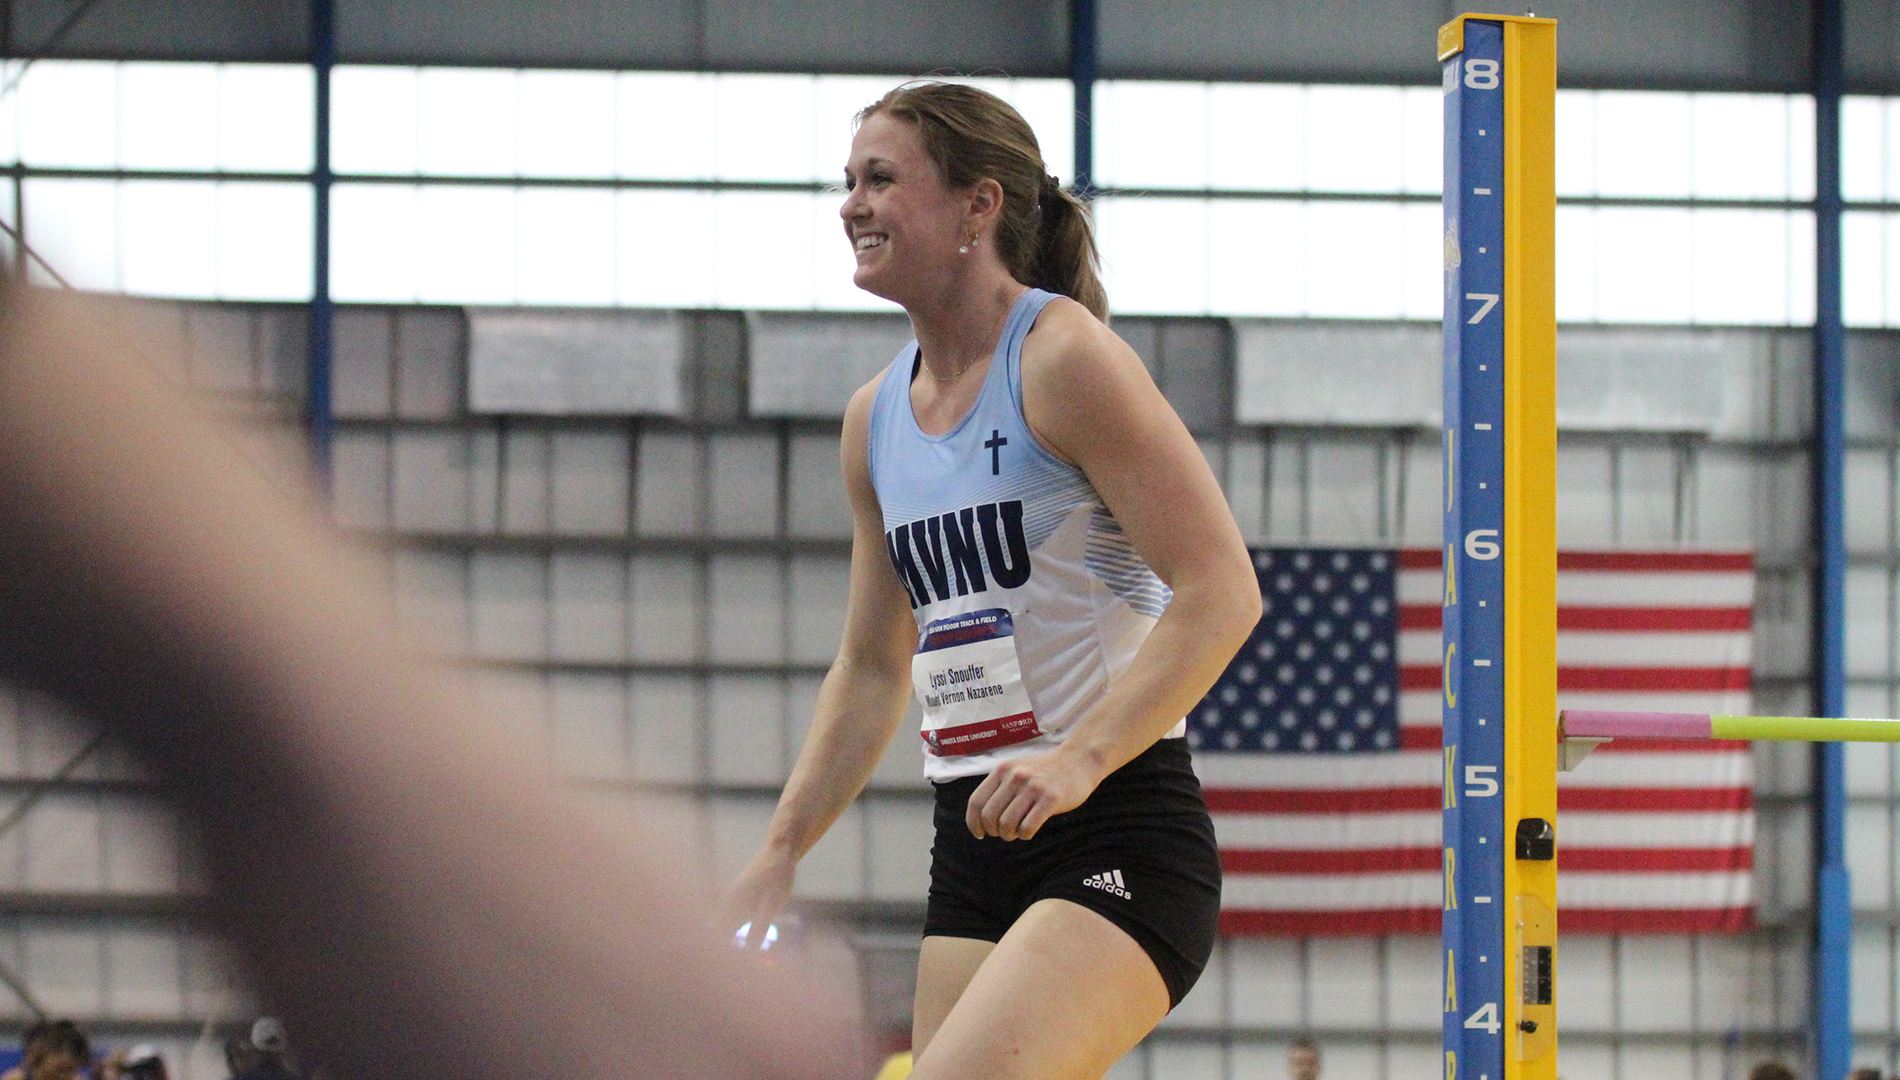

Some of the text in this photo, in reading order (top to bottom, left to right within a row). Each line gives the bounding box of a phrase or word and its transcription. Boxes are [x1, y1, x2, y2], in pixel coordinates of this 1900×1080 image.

[1464, 58, 1499, 89] 8
[1466, 293, 1499, 324] 7
[886, 500, 1031, 609] MVNU
[1464, 529, 1500, 560] 6
[980, 616, 997, 624] FIELD
[929, 664, 984, 690] Lyssi Snouffer
[941, 691, 965, 705] Vernon
[966, 684, 1004, 701] Nazarene
[1465, 765, 1499, 797] 5
[1083, 878, 1132, 900] adidas
[1464, 1002, 1501, 1034] 4
